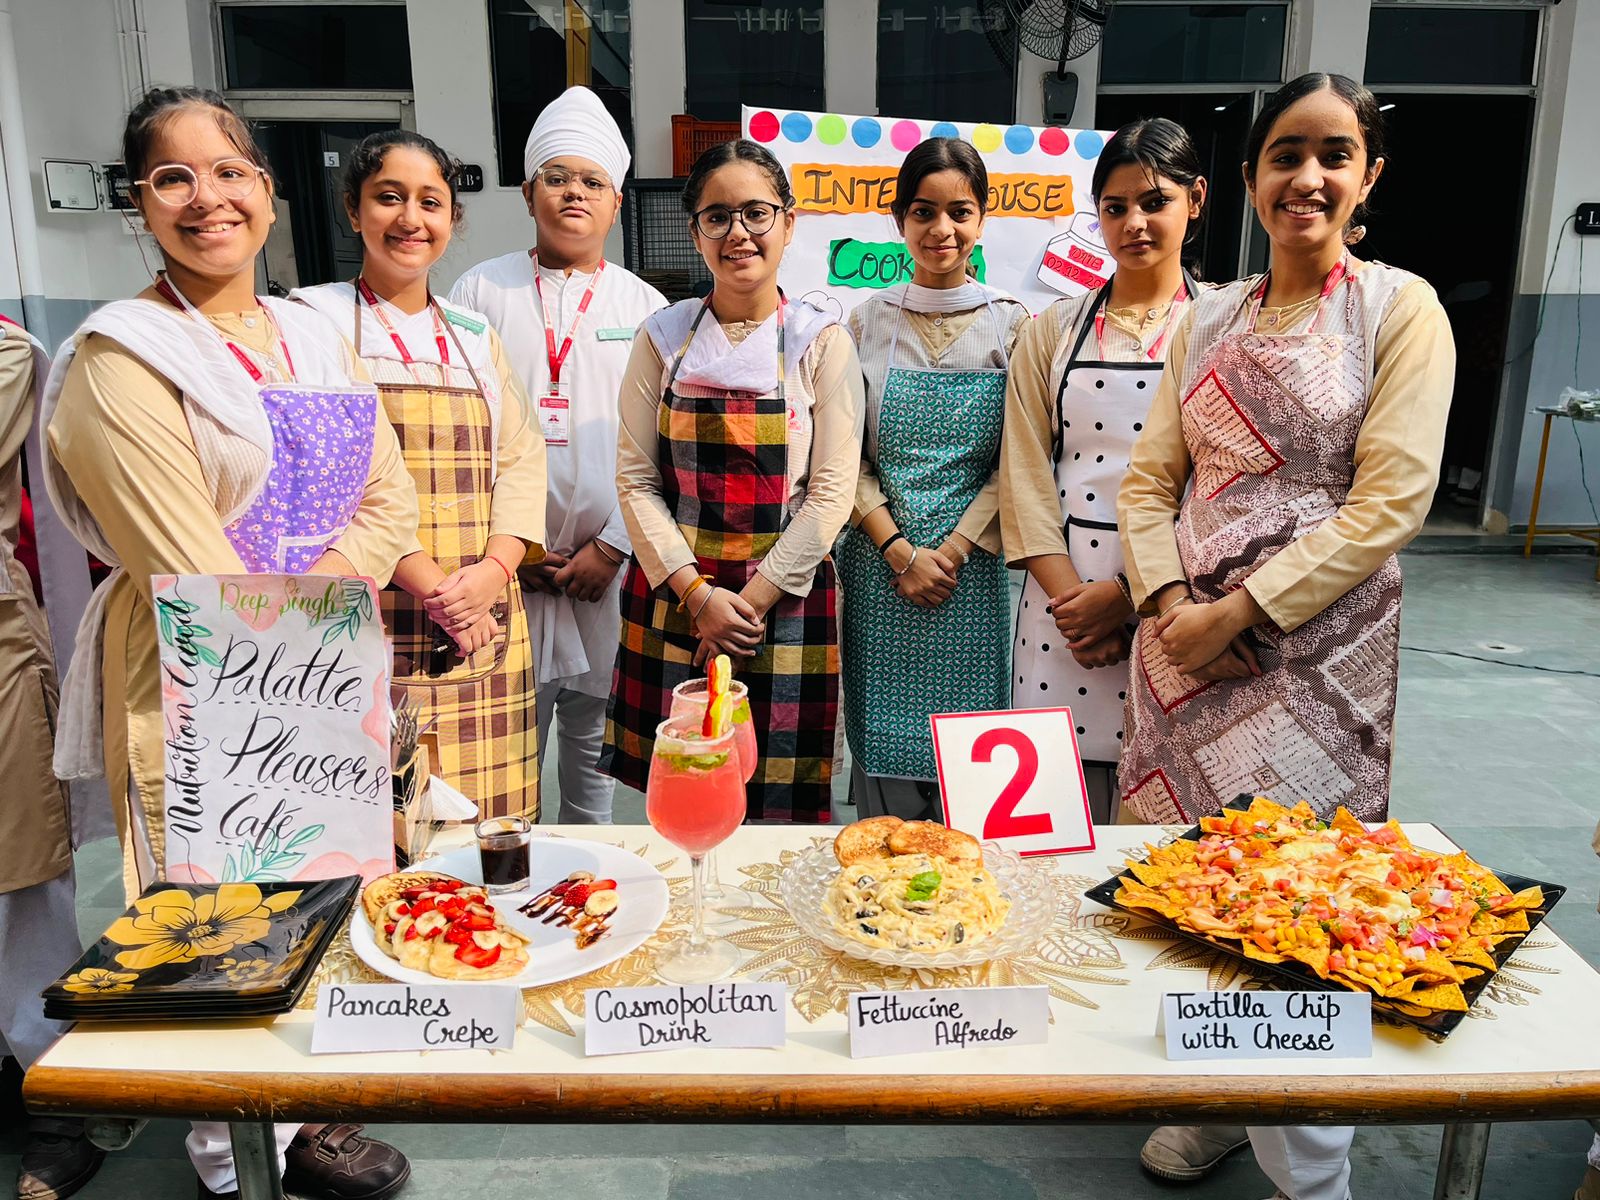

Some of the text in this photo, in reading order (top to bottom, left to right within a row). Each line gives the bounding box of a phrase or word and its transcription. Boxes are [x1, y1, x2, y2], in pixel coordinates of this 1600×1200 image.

[328, 155, 335, 166] 5
[802, 169, 1066, 213] INTE OUSE
[828, 237, 980, 284] COOK
[1045, 256, 1108, 288] 02.12.20
[1072, 247, 1101, 270] DATE
[219, 582, 271, 623] Deep
[203, 633, 363, 708] Palatte
[157, 593, 210, 837] Nutrition Card
[219, 707, 390, 799] Pleasers
[970, 727, 1054, 841] 2
[219, 792, 303, 857] Café
[327, 986, 451, 1018] Pancakes
[594, 983, 778, 1025] Cosmopolitan
[857, 995, 964, 1028] Fettuccine
[1166, 991, 1341, 1032] Tortilla Chip
[423, 1018, 499, 1049] Crepe
[638, 1018, 712, 1047] Drink
[935, 1018, 1018, 1049] Alfredo
[1181, 1022, 1334, 1051] with Cheese
